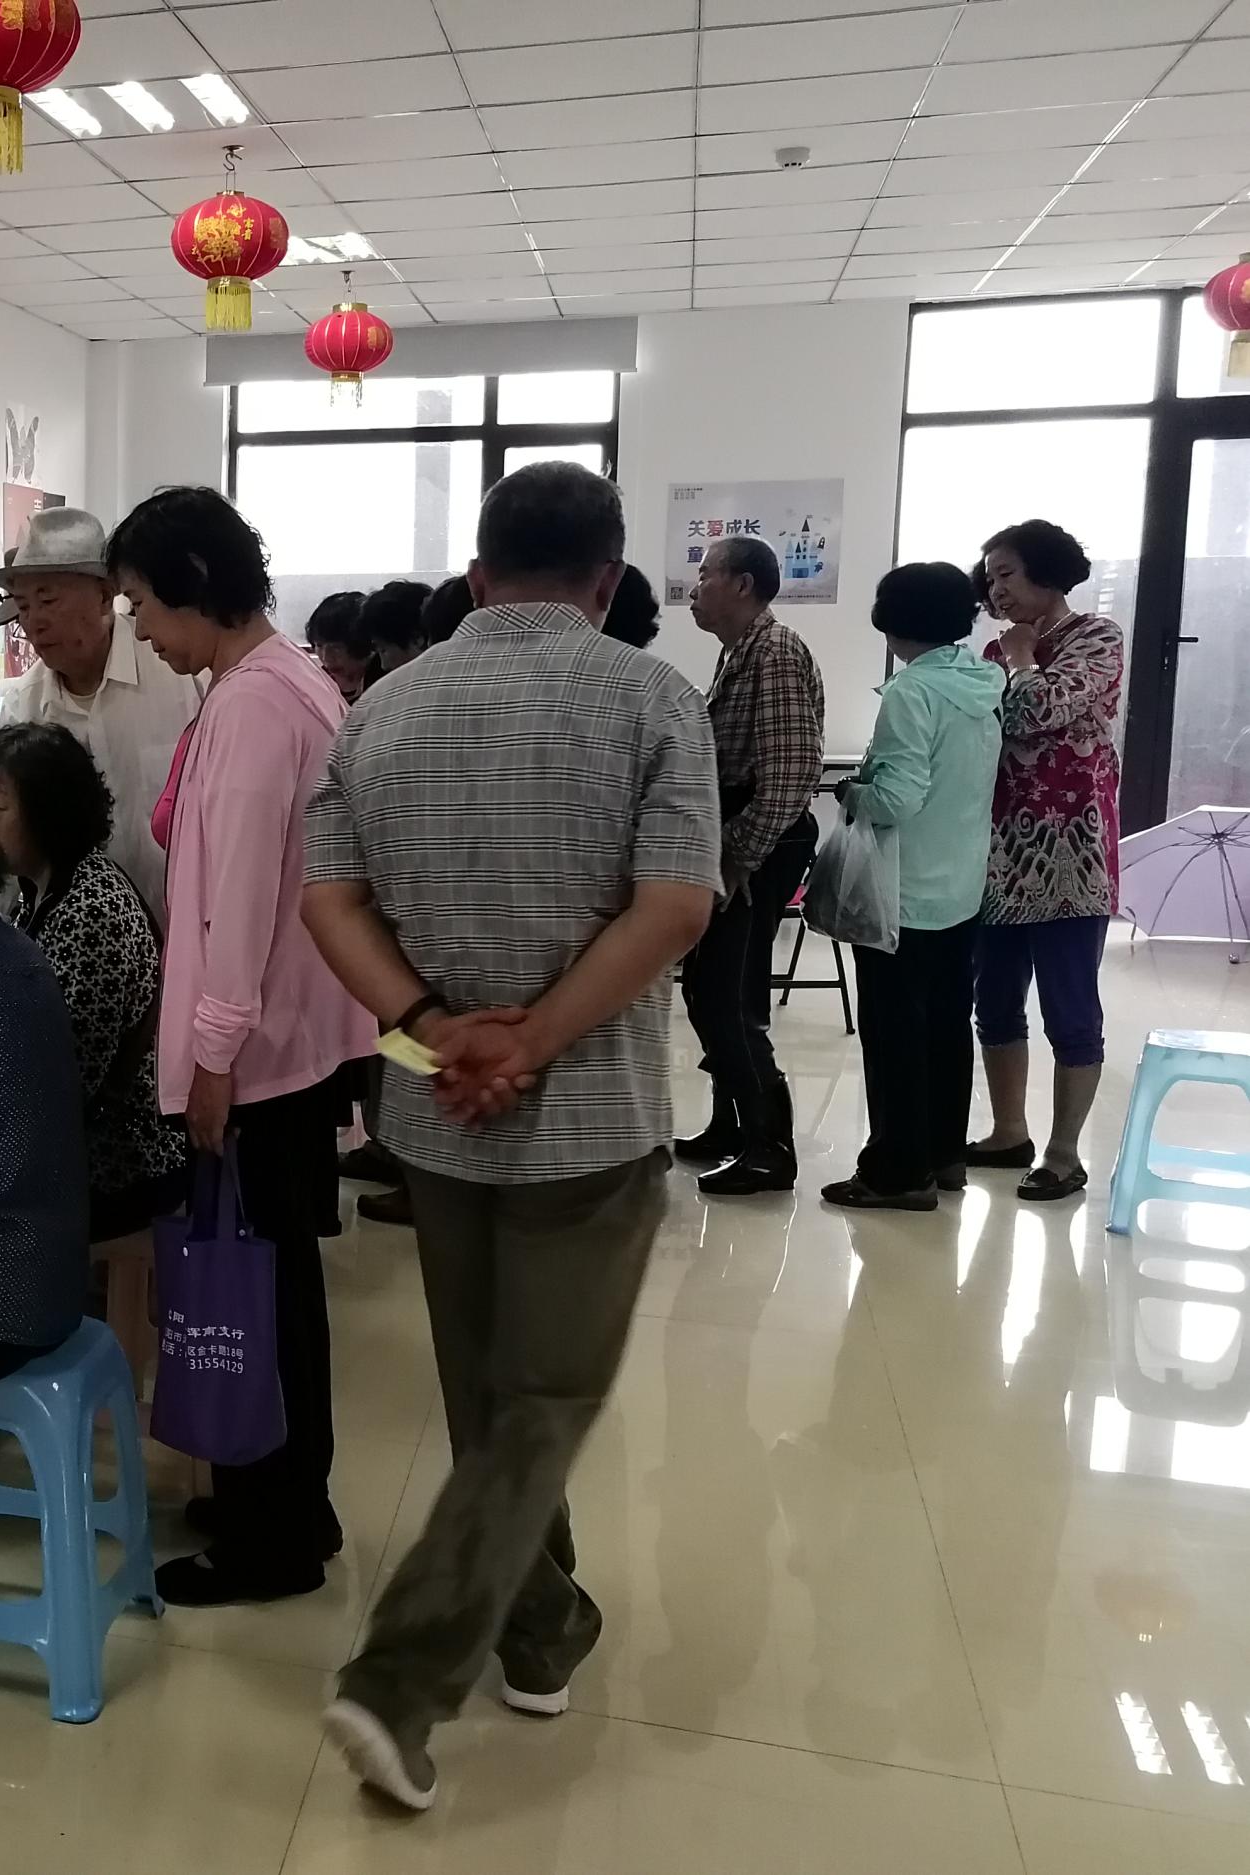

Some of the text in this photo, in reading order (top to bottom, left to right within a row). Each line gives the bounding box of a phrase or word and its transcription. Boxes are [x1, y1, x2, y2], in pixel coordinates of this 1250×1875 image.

[687, 519, 762, 537] 关爱成长
[189, 1357, 244, 1374] 31554129
